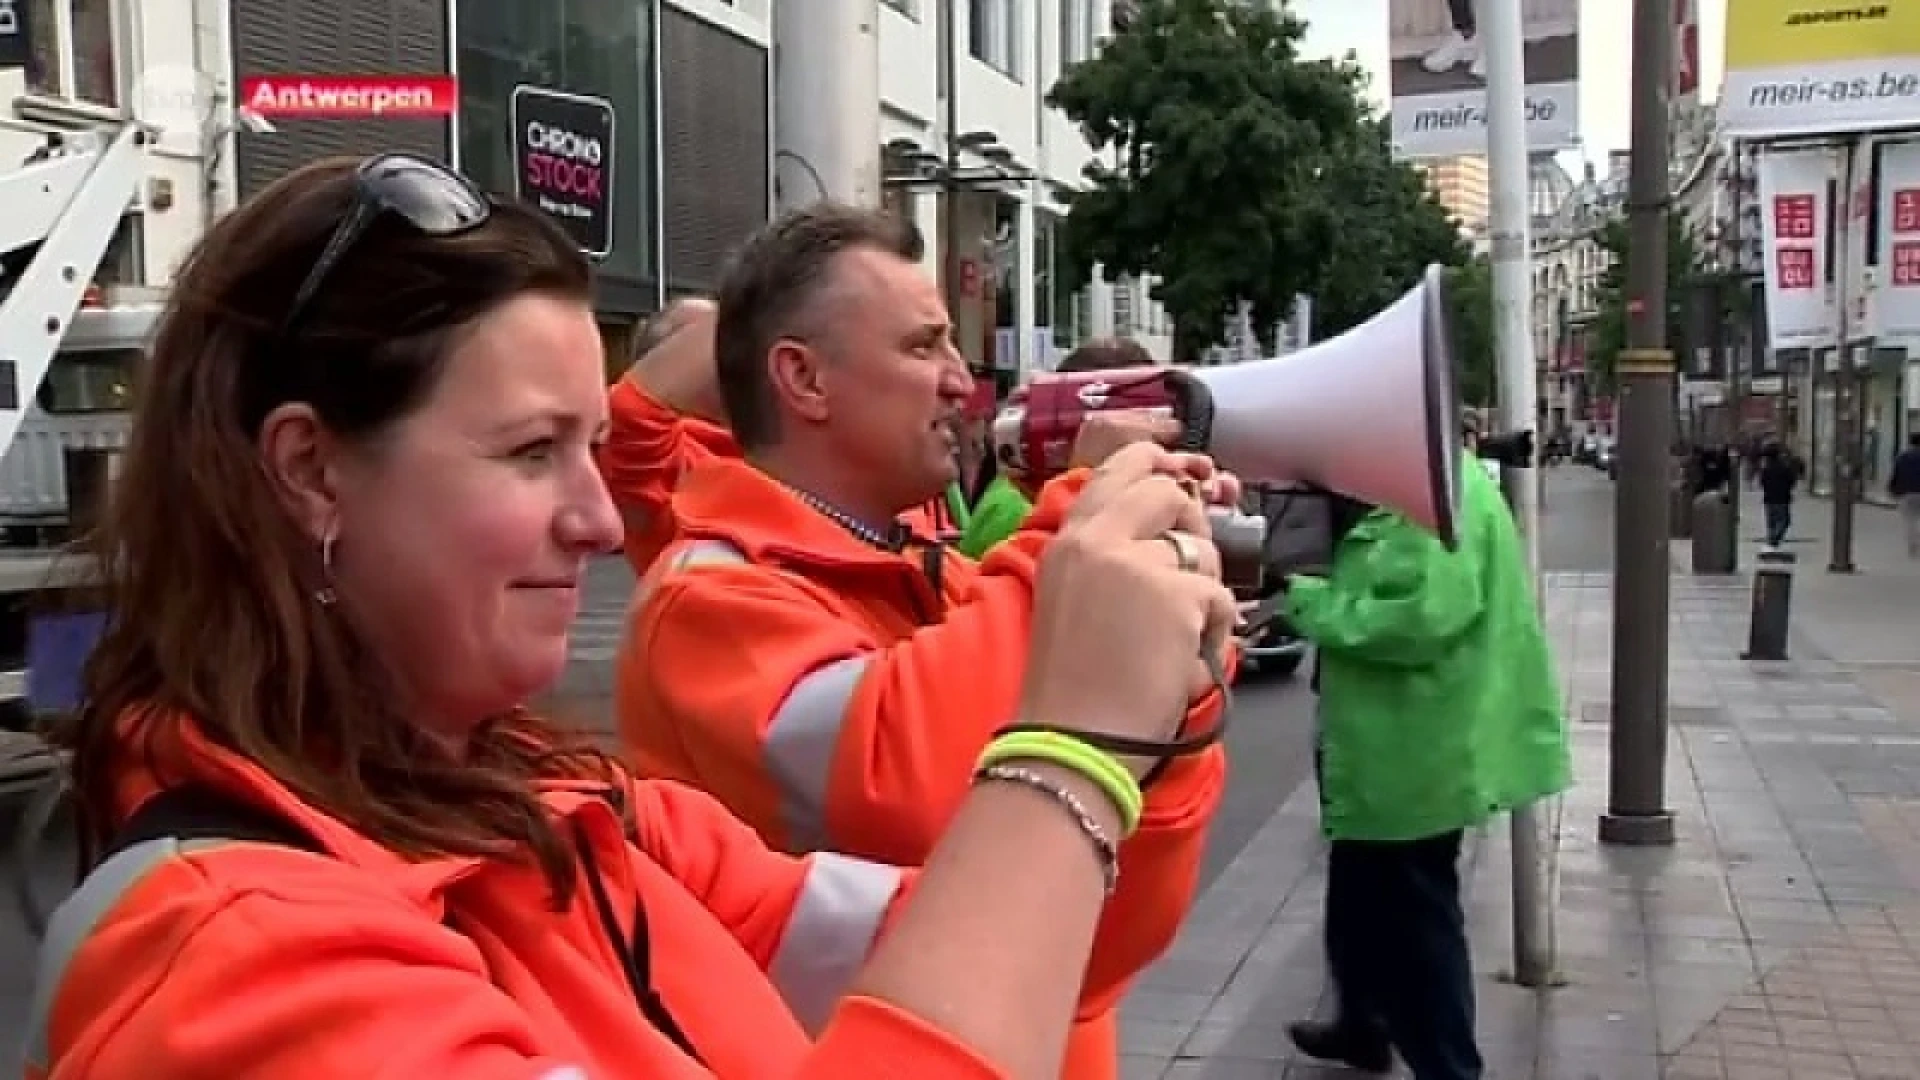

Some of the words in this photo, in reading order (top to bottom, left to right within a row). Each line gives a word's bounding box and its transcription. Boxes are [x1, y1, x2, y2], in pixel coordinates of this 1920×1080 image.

[1750, 71, 1919, 108] meir-as.be
[1414, 97, 1558, 132] meir-be
[527, 121, 601, 166] CHRONO
[527, 153, 602, 198] STOCK
